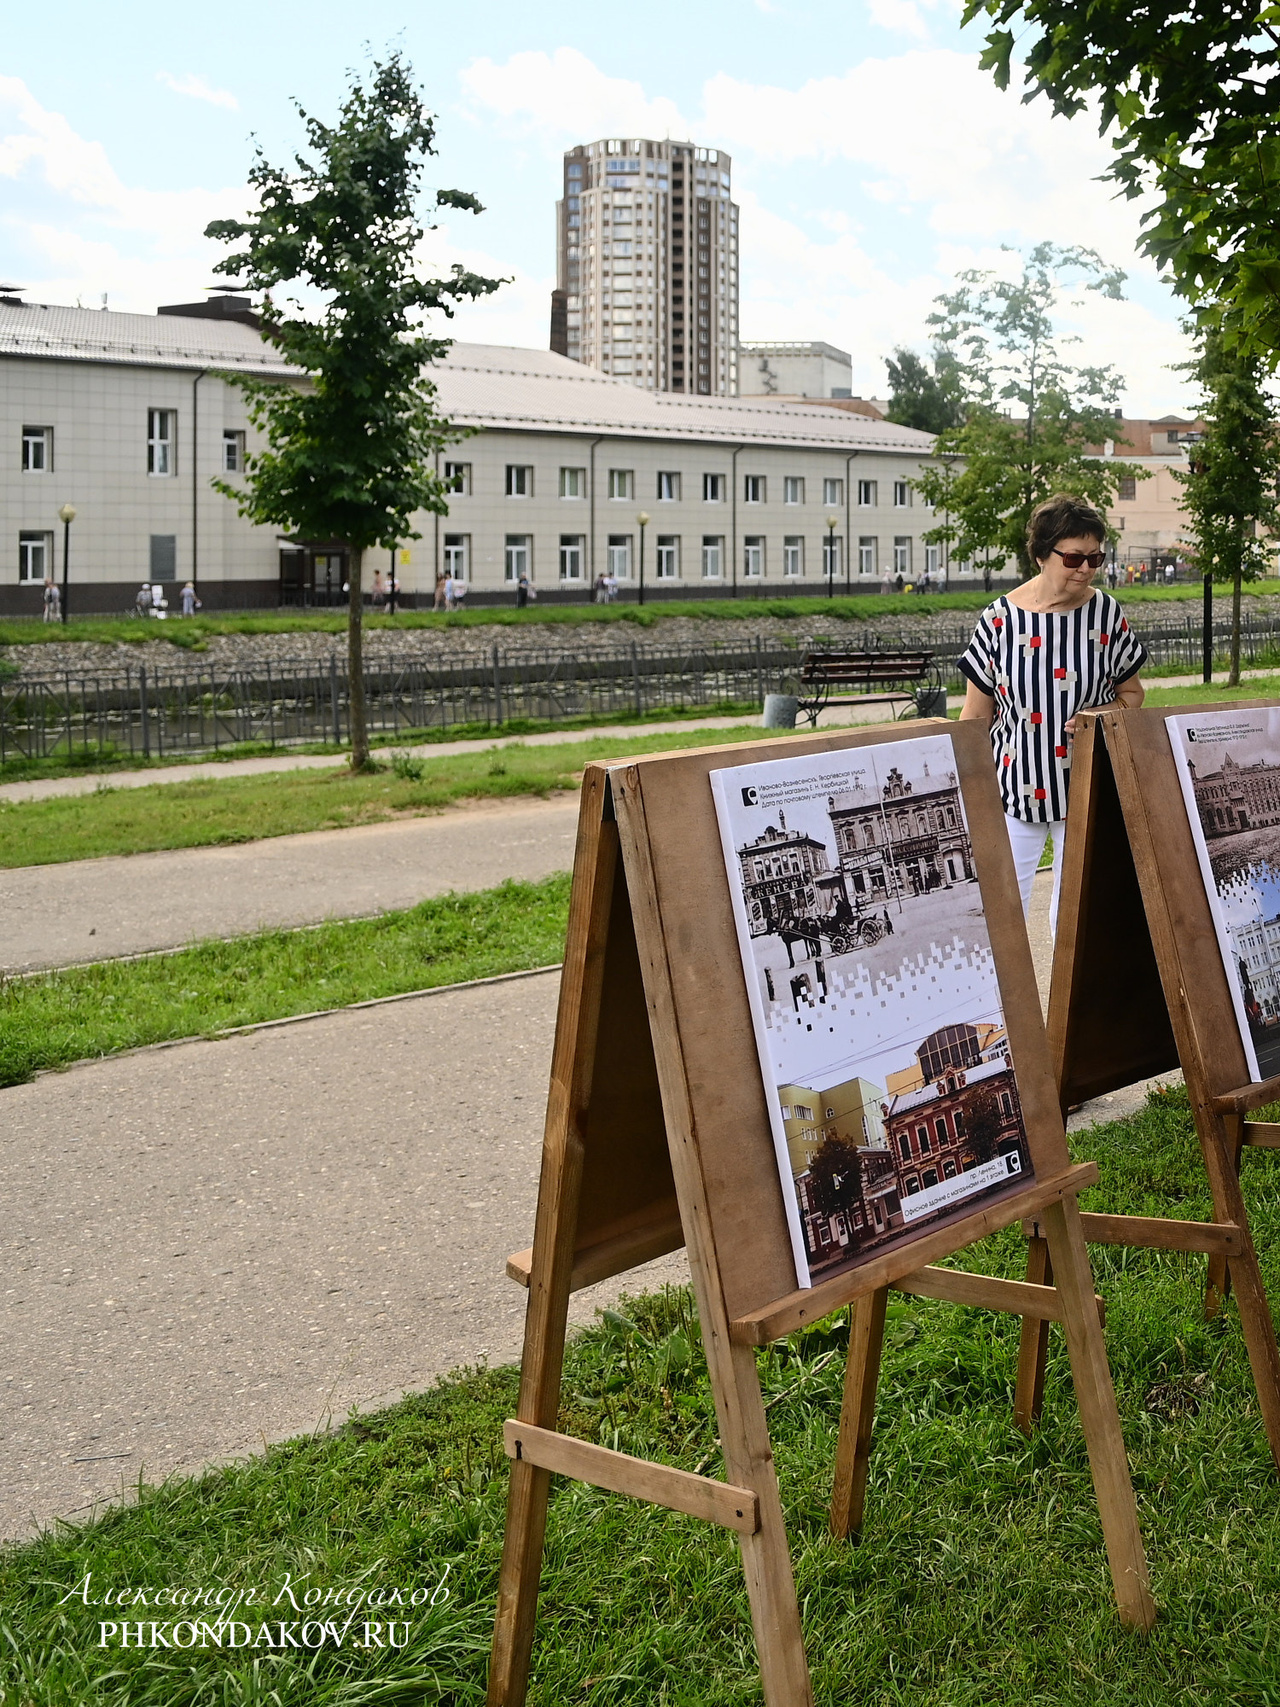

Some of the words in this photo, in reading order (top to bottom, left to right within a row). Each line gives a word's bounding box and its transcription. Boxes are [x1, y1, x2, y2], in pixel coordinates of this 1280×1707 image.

[760, 790, 784, 800] Книжный
[783, 795, 811, 804] почтовому
[754, 881, 806, 898] ЖЕНЕВА
[904, 1202, 928, 1216] Офисное
[928, 1196, 946, 1207] здание
[950, 1180, 978, 1196] магазинами
